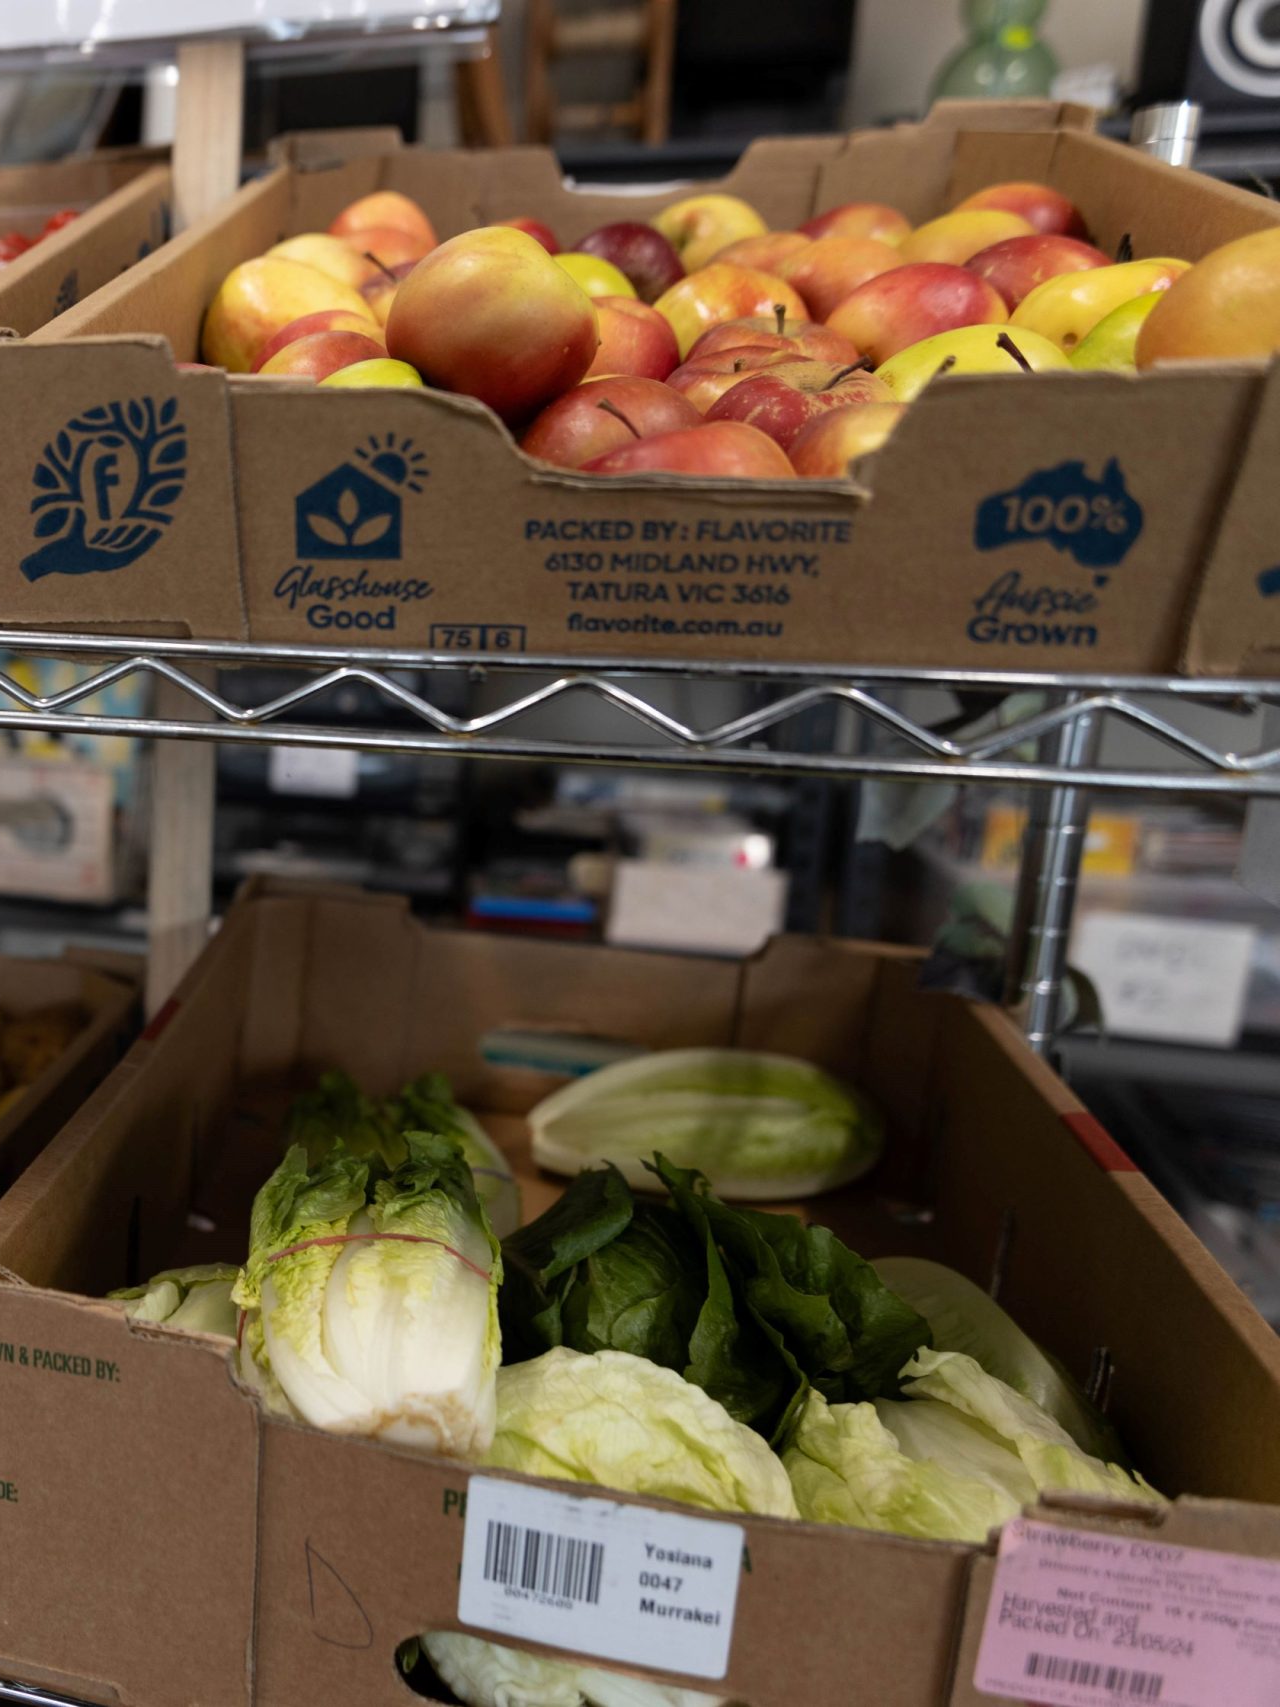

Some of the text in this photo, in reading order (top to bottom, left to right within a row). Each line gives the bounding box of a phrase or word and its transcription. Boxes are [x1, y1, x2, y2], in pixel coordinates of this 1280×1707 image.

[1001, 494, 1129, 535] 100%
[524, 519, 635, 543] PACKED
[695, 519, 853, 544] FLAVORITE
[544, 551, 604, 574] 6130
[610, 552, 738, 576] MIDLAND
[273, 564, 435, 610] Glasshouse
[567, 581, 791, 606] TATURA VIC 3616
[972, 569, 1099, 615] Aussie
[306, 604, 397, 631] Good
[566, 611, 785, 639] flavorite.com.au
[966, 614, 1099, 647] Grown
[441, 628, 511, 649] 75 6
[18, 1346, 29, 1366] &
[32, 1347, 92, 1379] PACKED
[95, 1360, 121, 1384] BY:
[638, 1570, 684, 1594] 0047
[998, 1606, 1068, 1637] Packed
[1002, 1590, 1141, 1630] Harvested and
